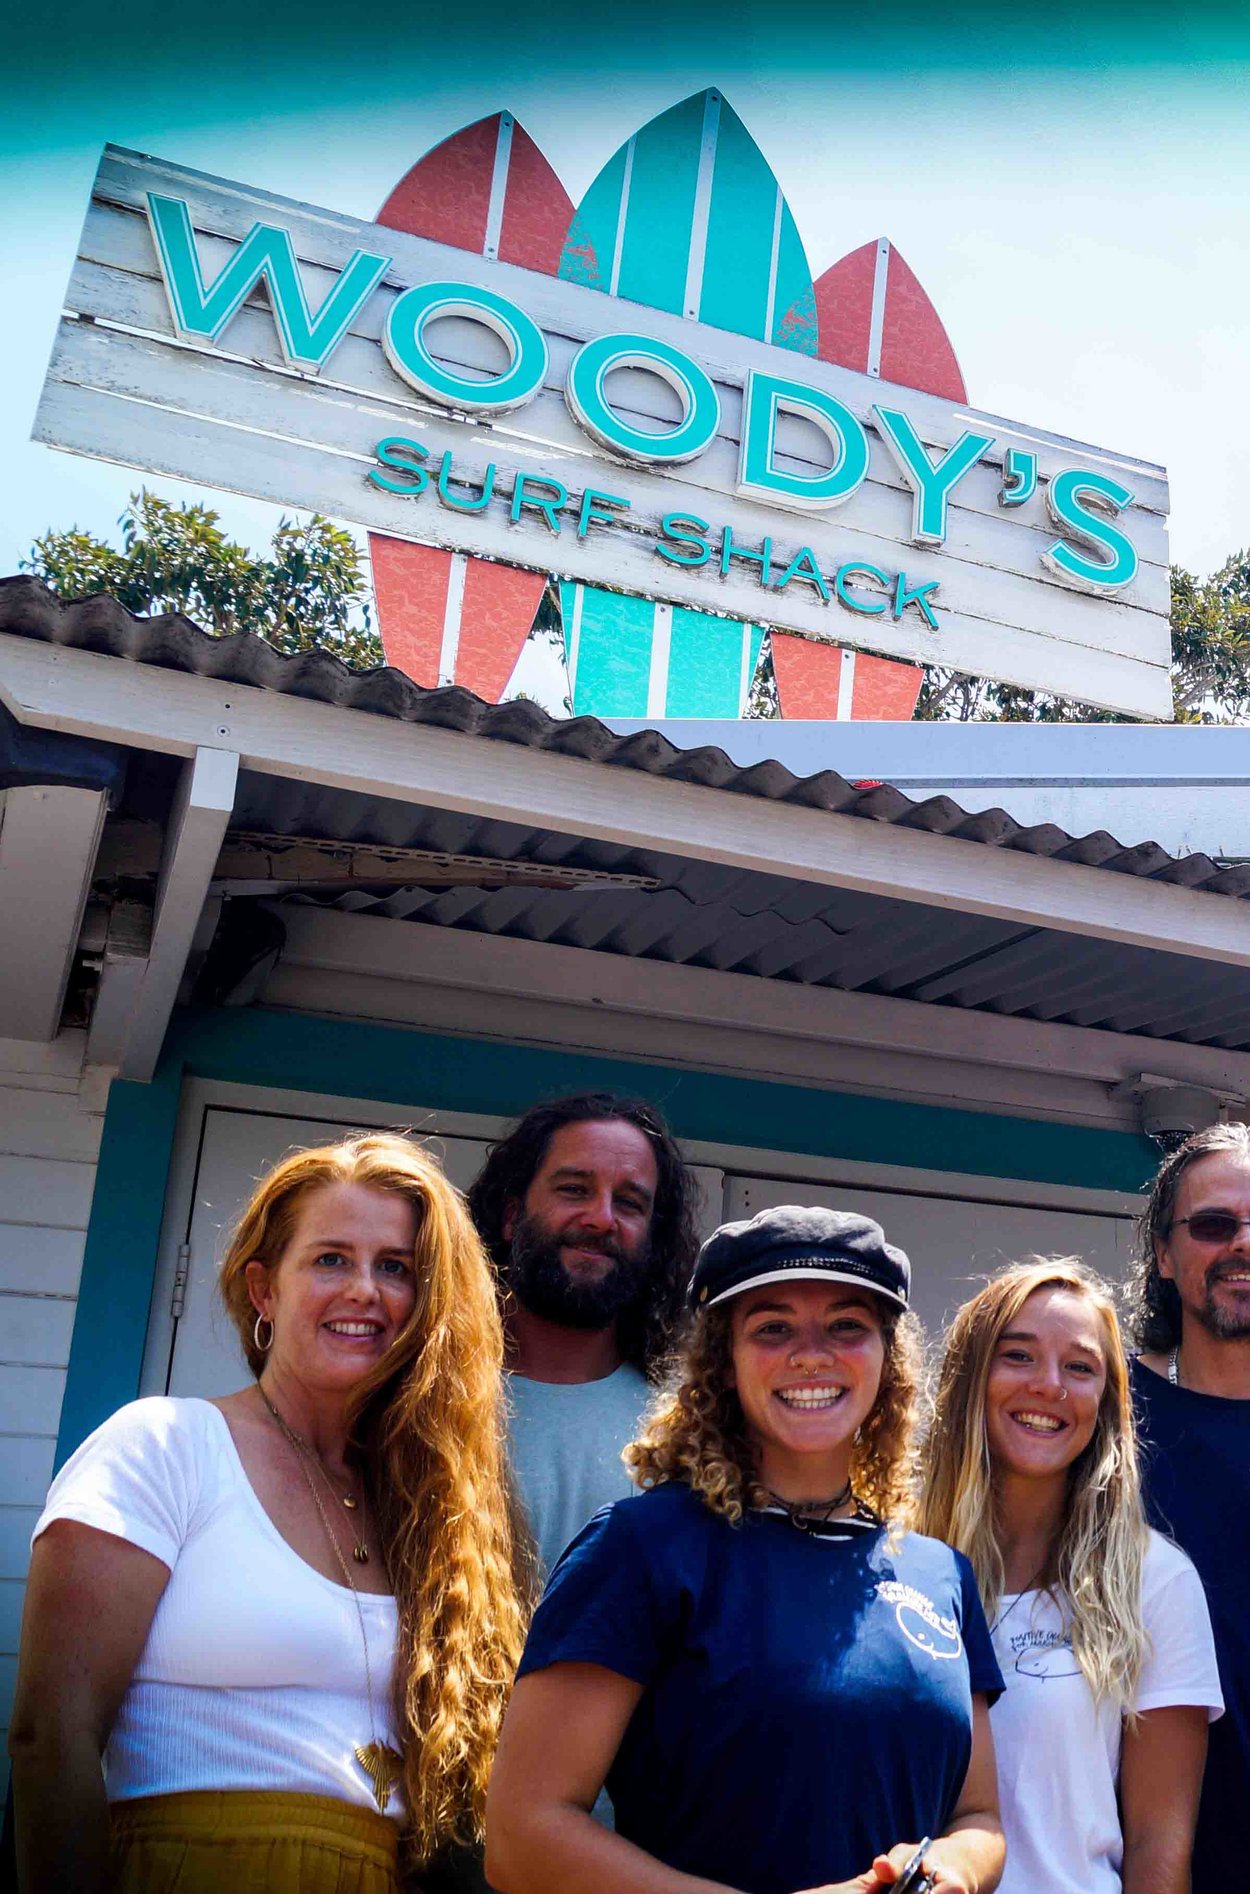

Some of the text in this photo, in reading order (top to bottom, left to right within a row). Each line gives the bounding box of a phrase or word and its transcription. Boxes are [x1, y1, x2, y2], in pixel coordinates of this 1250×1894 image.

[146, 191, 1140, 597] WOODY'S
[368, 435, 941, 631] SURF SHACK
